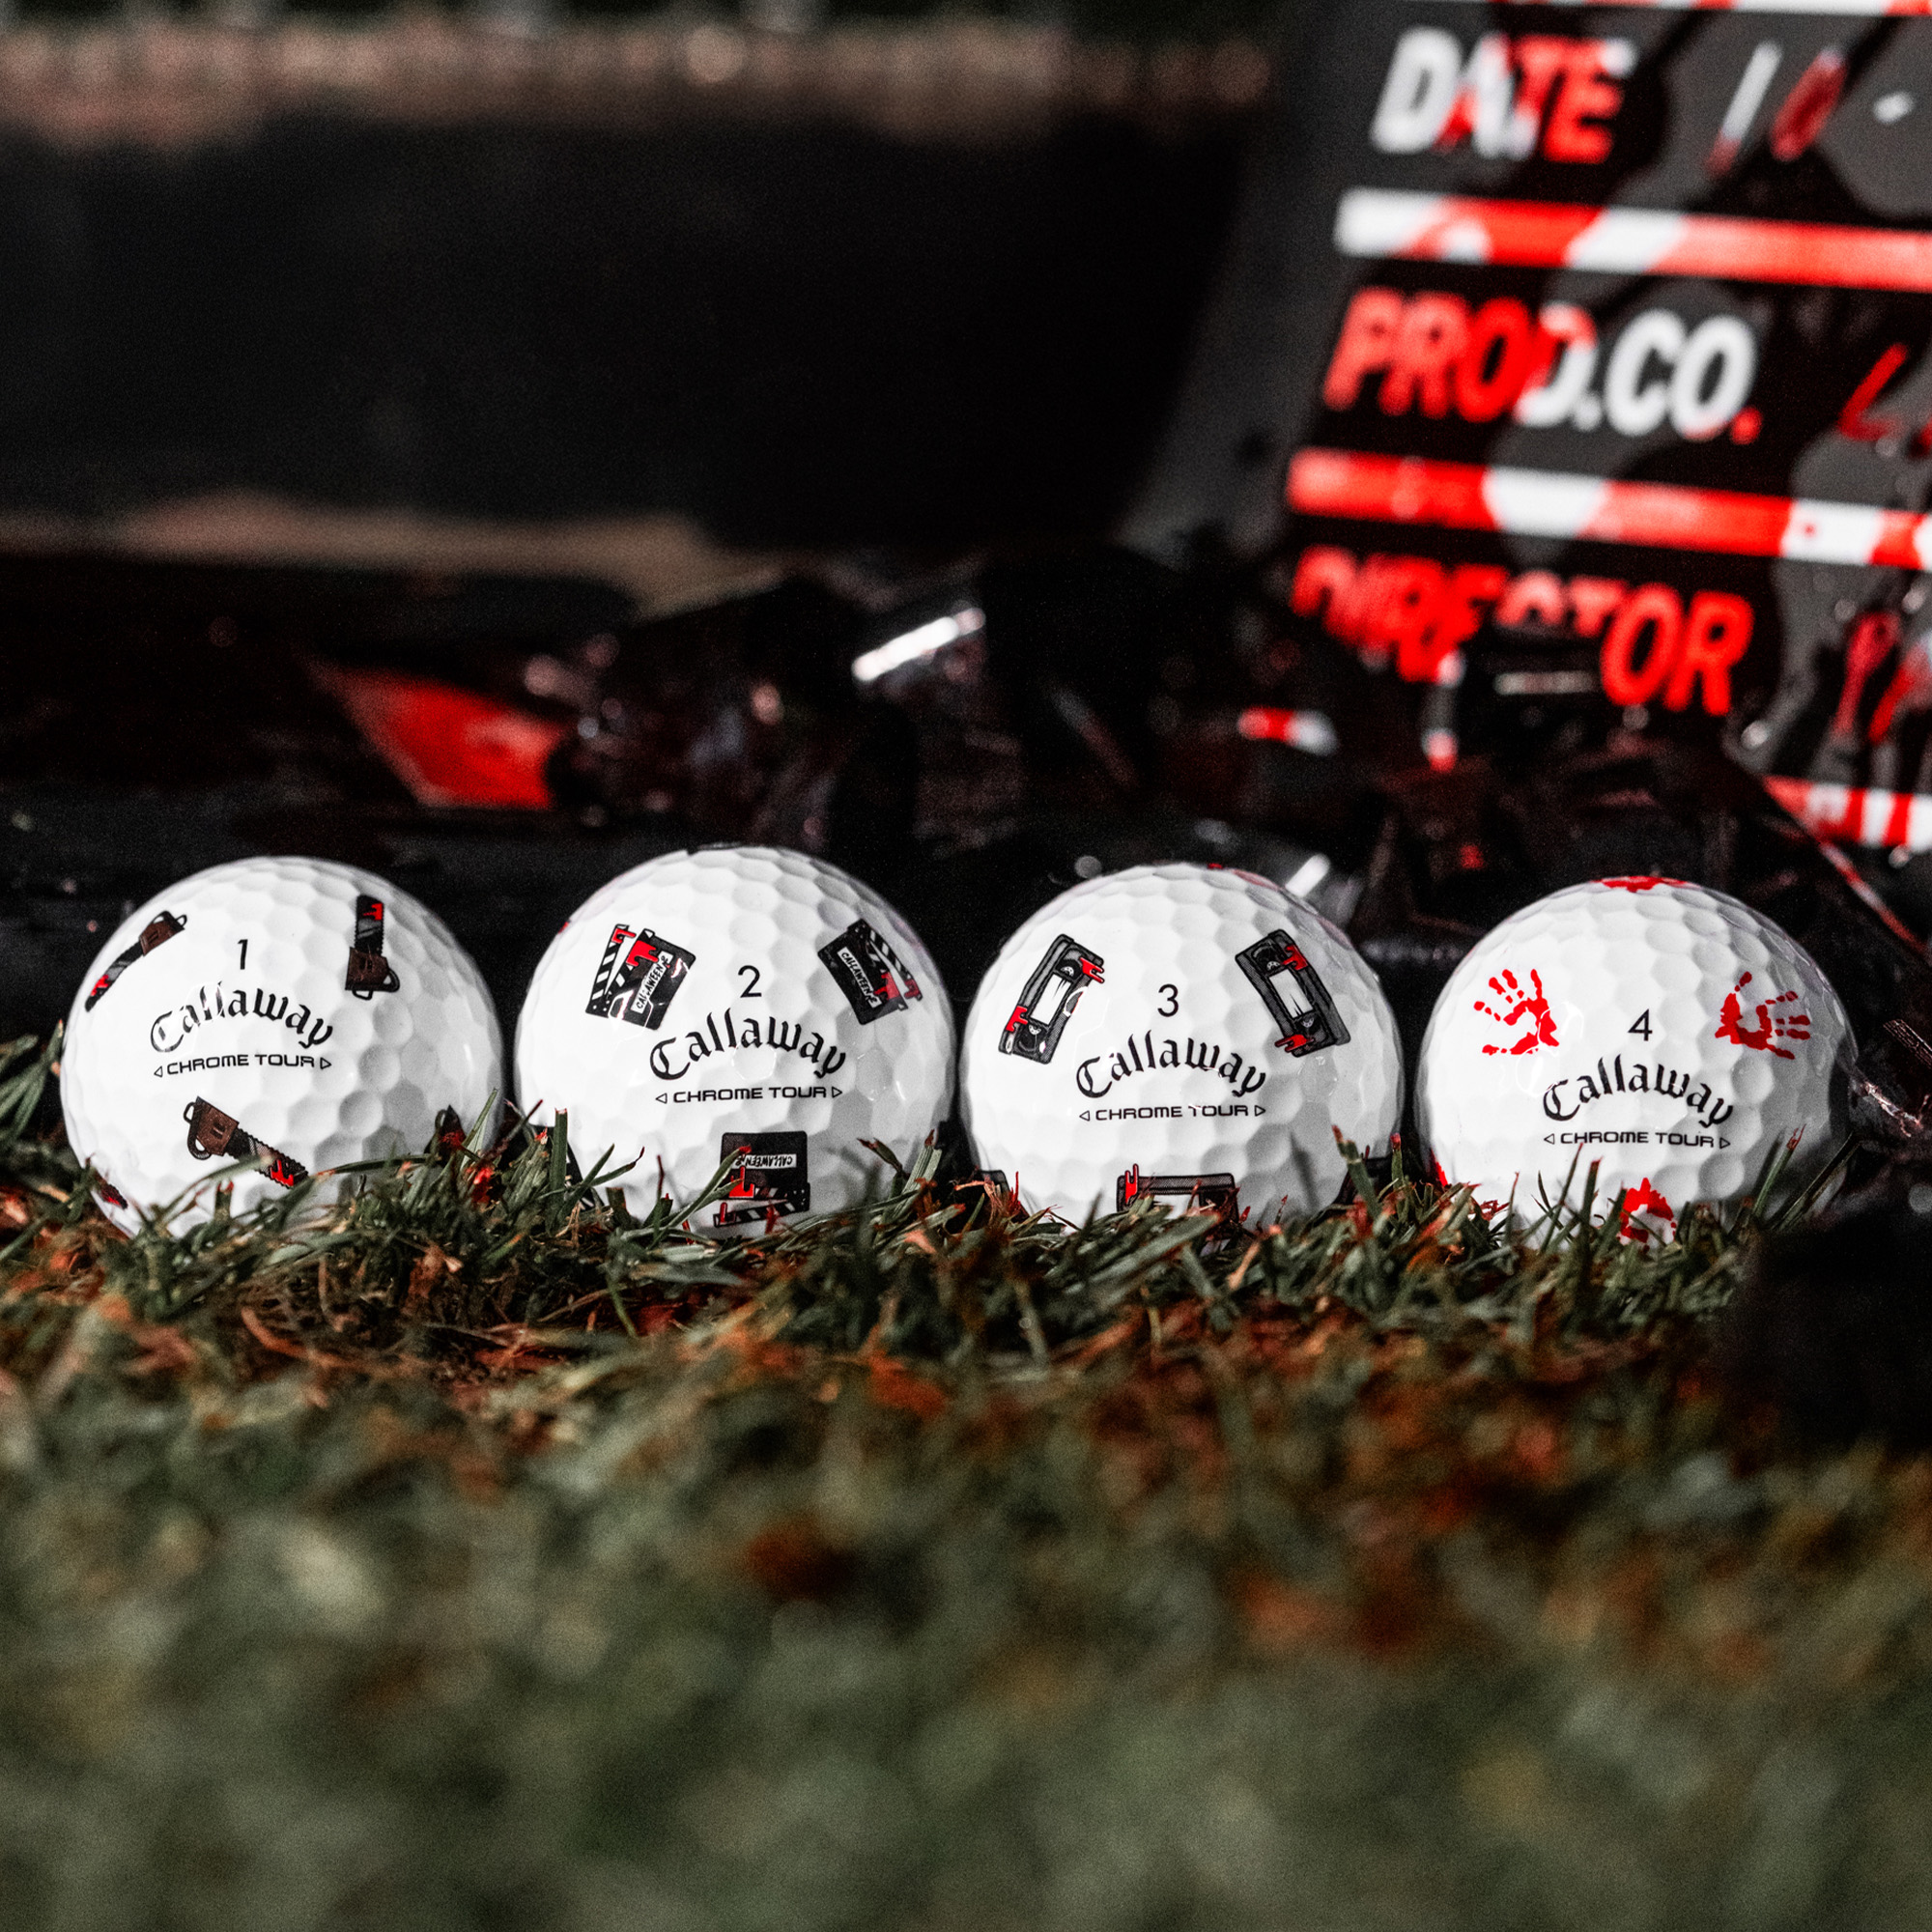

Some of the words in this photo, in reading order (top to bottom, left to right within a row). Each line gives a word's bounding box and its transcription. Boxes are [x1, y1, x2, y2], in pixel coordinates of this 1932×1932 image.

[1369, 27, 1634, 164] DATE
[237, 938, 248, 970] 1
[737, 964, 762, 999] 2
[150, 980, 334, 1053] Callaway
[1157, 983, 1179, 1017] 3
[1627, 1009, 1653, 1041] 4
[649, 1008, 847, 1081] Callaway
[166, 1054, 250, 1075] CHROME
[254, 1054, 315, 1068] TOUR
[1075, 1029, 1266, 1099] Callaway
[673, 1087, 763, 1103] CHROME
[768, 1086, 827, 1099] TOUR
[1543, 1053, 1734, 1129] Callaway
[1095, 1106, 1183, 1121] CHROME
[1187, 1105, 1249, 1118] TOUR
[1560, 1131, 1649, 1145] CHROME
[1655, 1132, 1714, 1148] TOUR
